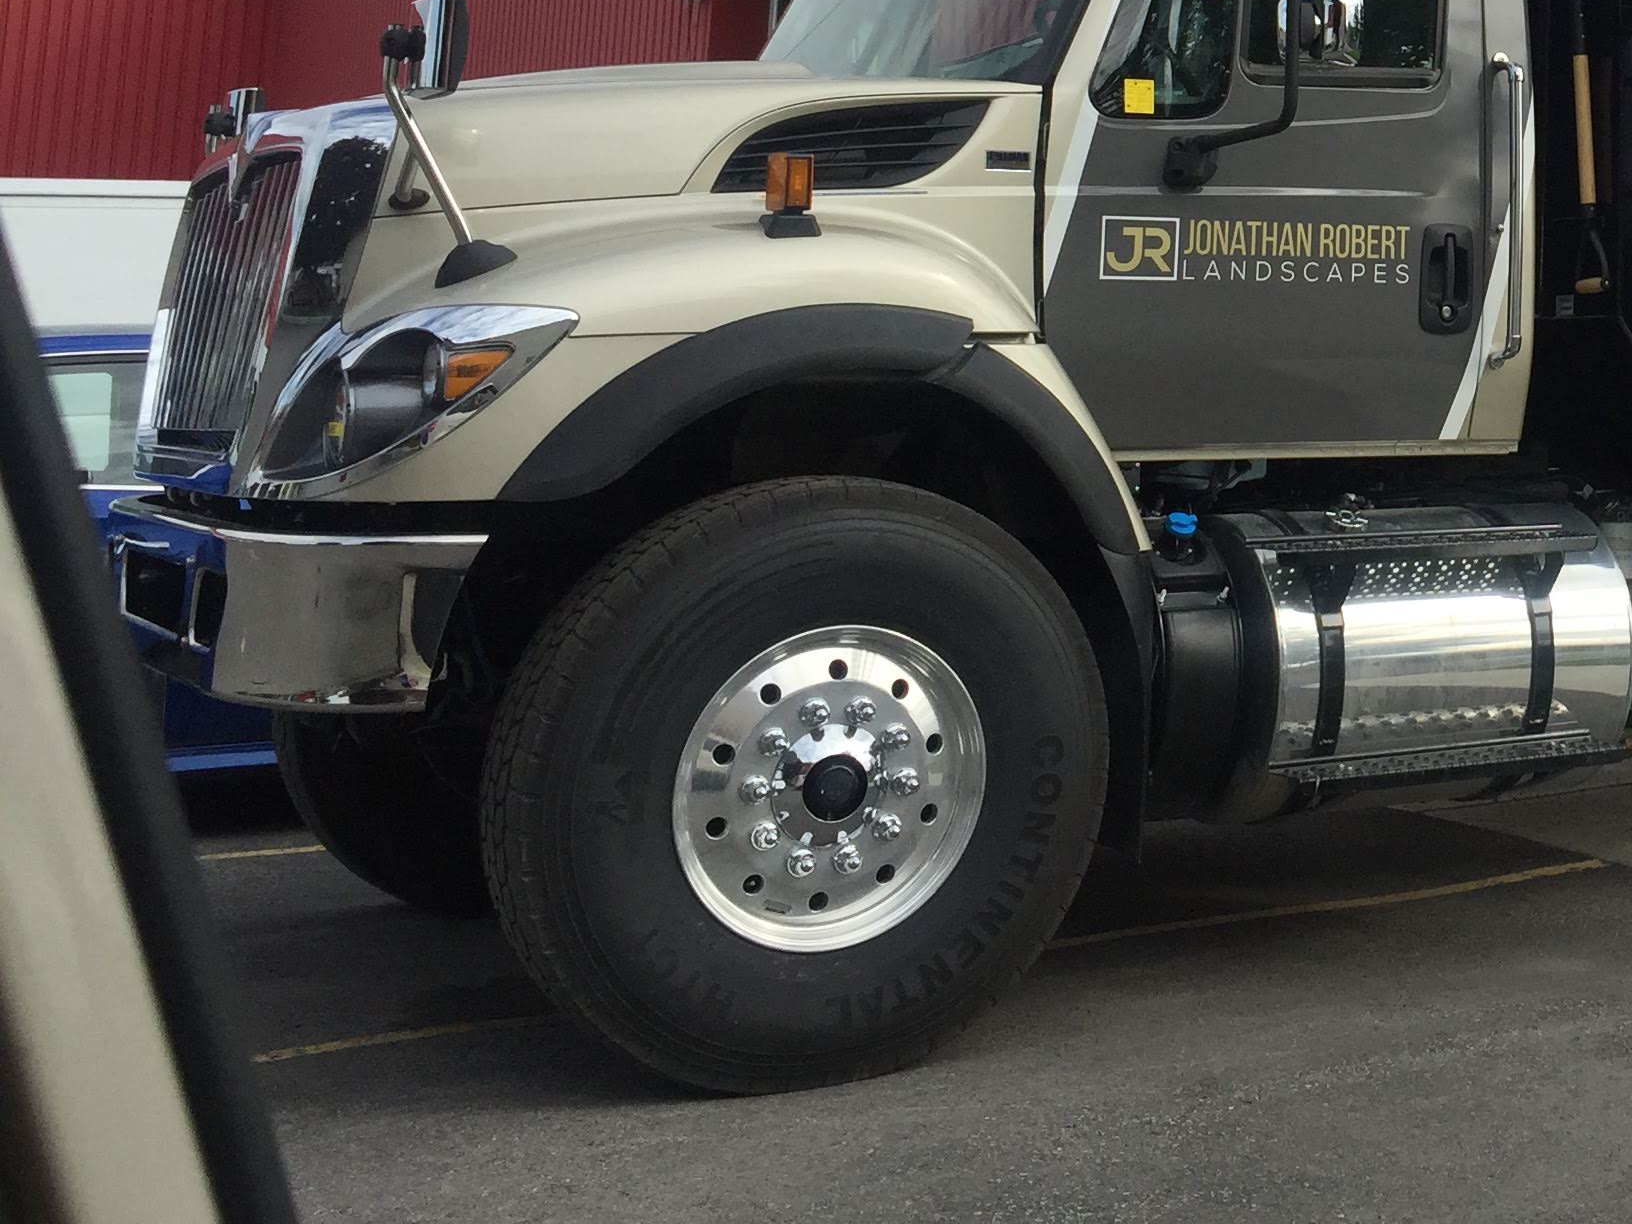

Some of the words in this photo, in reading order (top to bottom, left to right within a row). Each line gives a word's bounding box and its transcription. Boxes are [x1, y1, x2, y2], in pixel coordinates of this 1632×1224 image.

[1106, 226, 1172, 273] JR
[1184, 219, 1313, 258] JONATHAN
[1319, 223, 1411, 261] ROBERT
[1183, 259, 1410, 285] LANDSCAPES
[826, 733, 1066, 1026] CONTINENTAL
